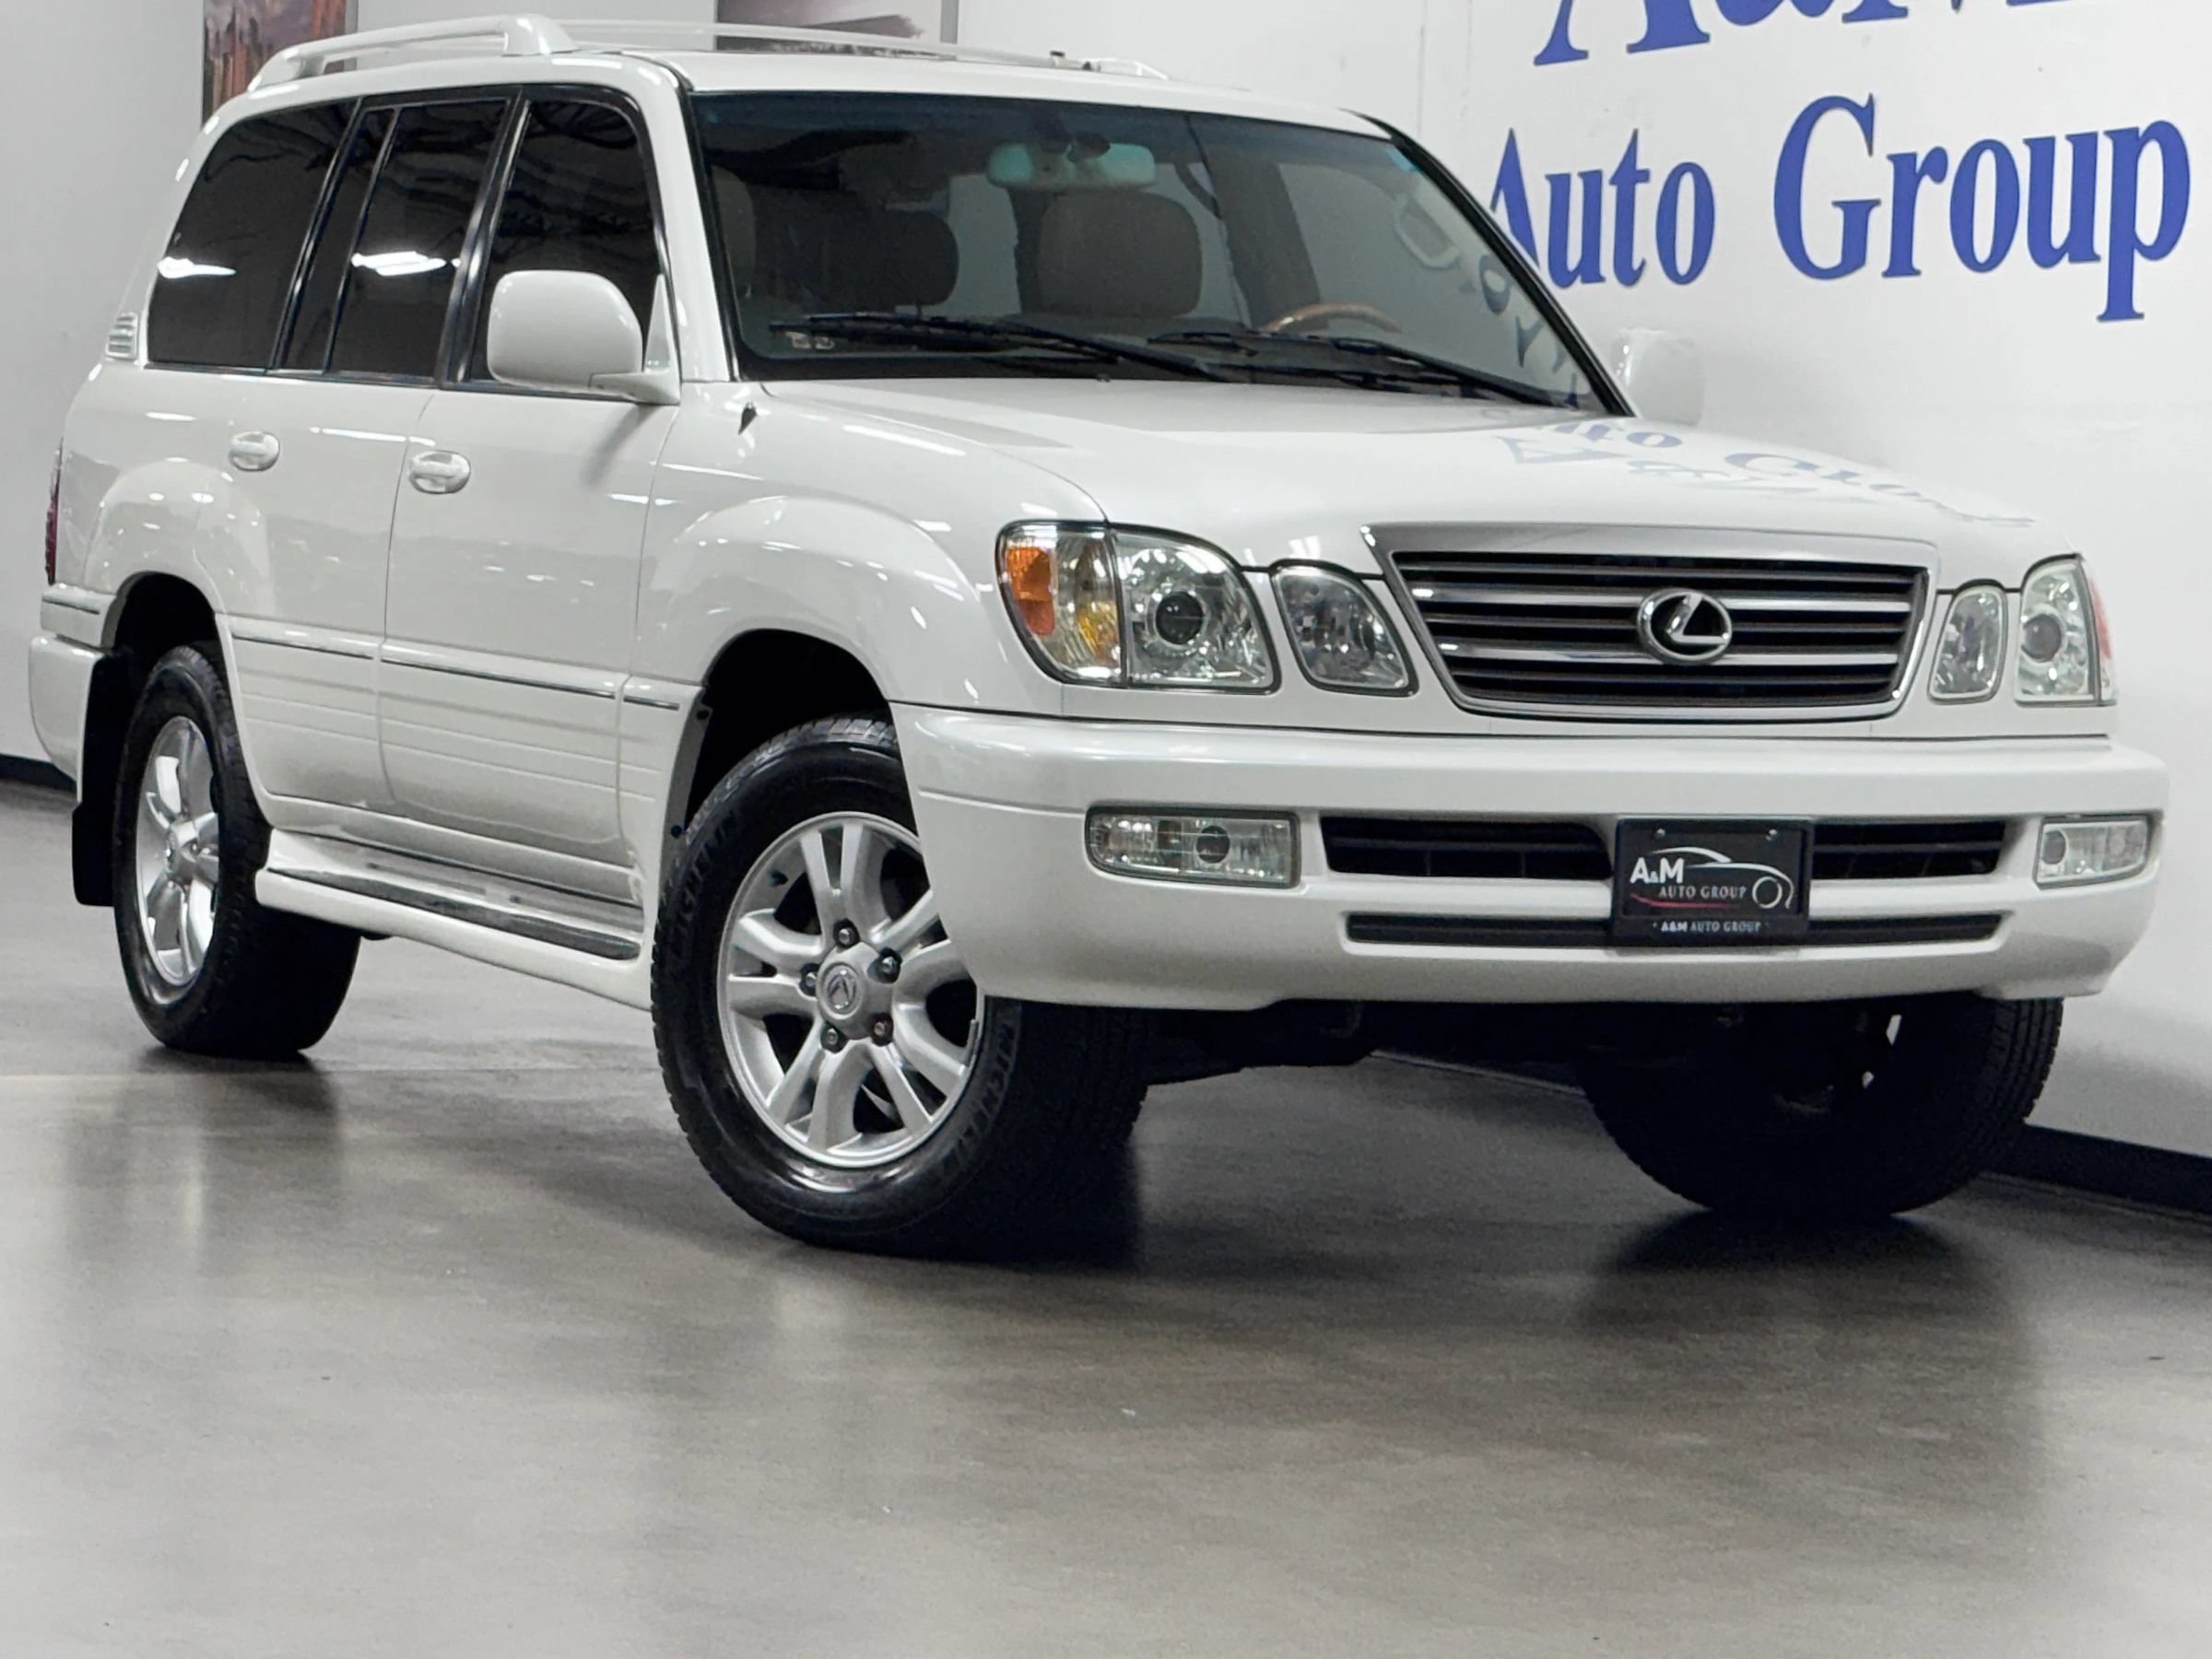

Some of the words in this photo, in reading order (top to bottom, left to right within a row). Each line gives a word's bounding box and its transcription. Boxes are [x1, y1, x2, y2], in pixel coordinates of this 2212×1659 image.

[1489, 127, 1716, 288] Auto
[1773, 94, 2192, 322] Group
[1630, 857, 1685, 884] A&M
[1659, 885, 1697, 900] AUTO
[1700, 885, 1747, 900] GROUP
[1690, 921, 1721, 933] AUTO
[1723, 921, 1761, 933] GROUP
